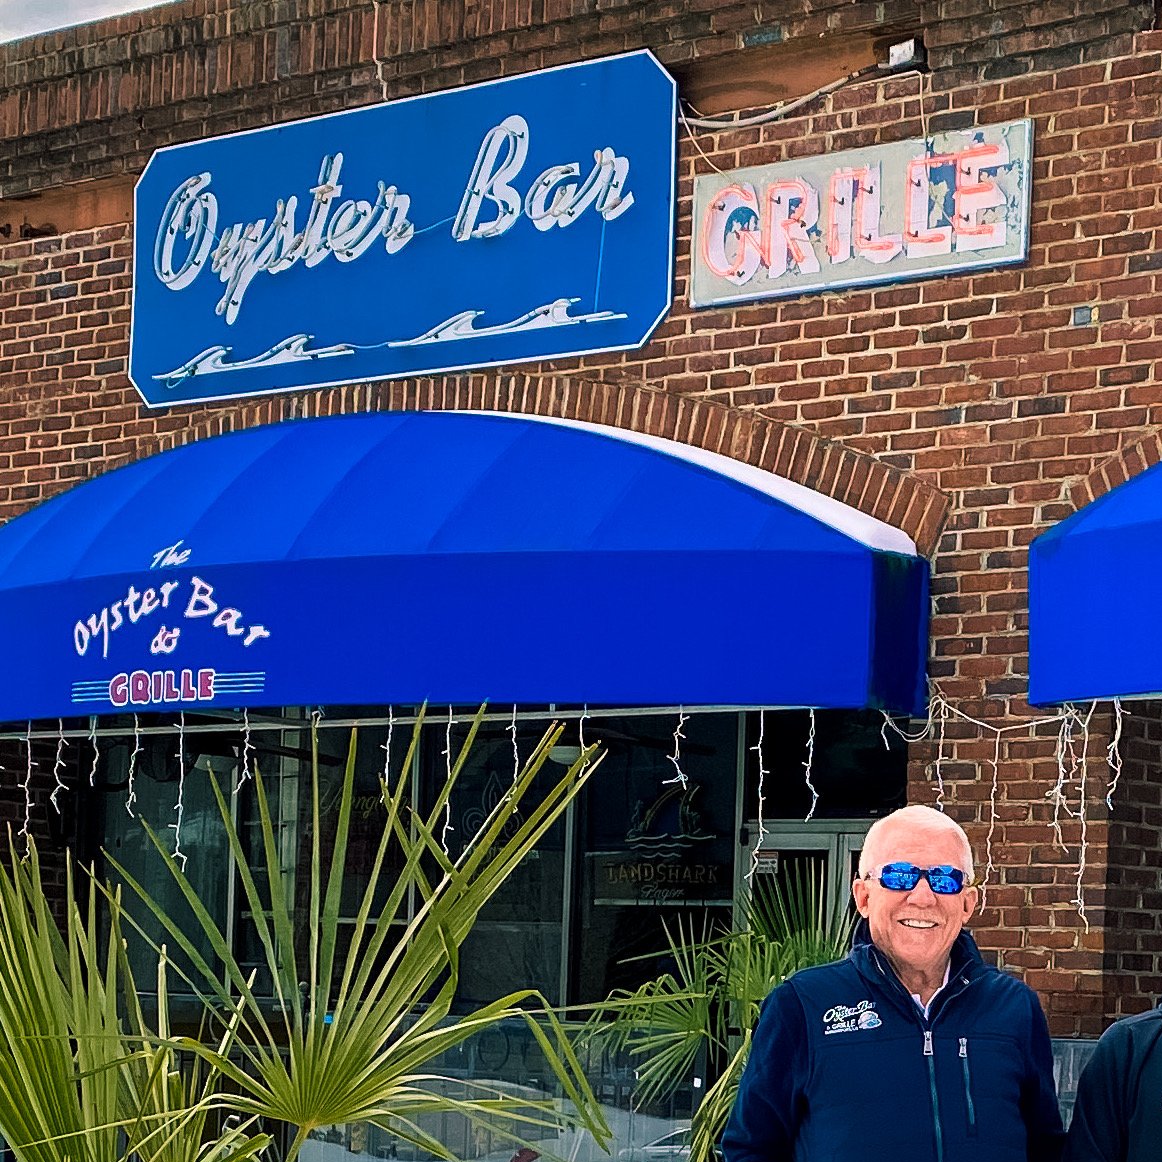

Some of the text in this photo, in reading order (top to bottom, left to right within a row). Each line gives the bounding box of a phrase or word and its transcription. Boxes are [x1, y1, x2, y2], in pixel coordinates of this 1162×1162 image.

[152, 115, 634, 325] Oyster Bar
[702, 144, 1010, 286] GRILLE
[150, 539, 192, 570] The
[74, 575, 271, 660] Oyster Bar
[108, 668, 216, 707] GRILLE
[603, 862, 720, 884] LANDSHARK
